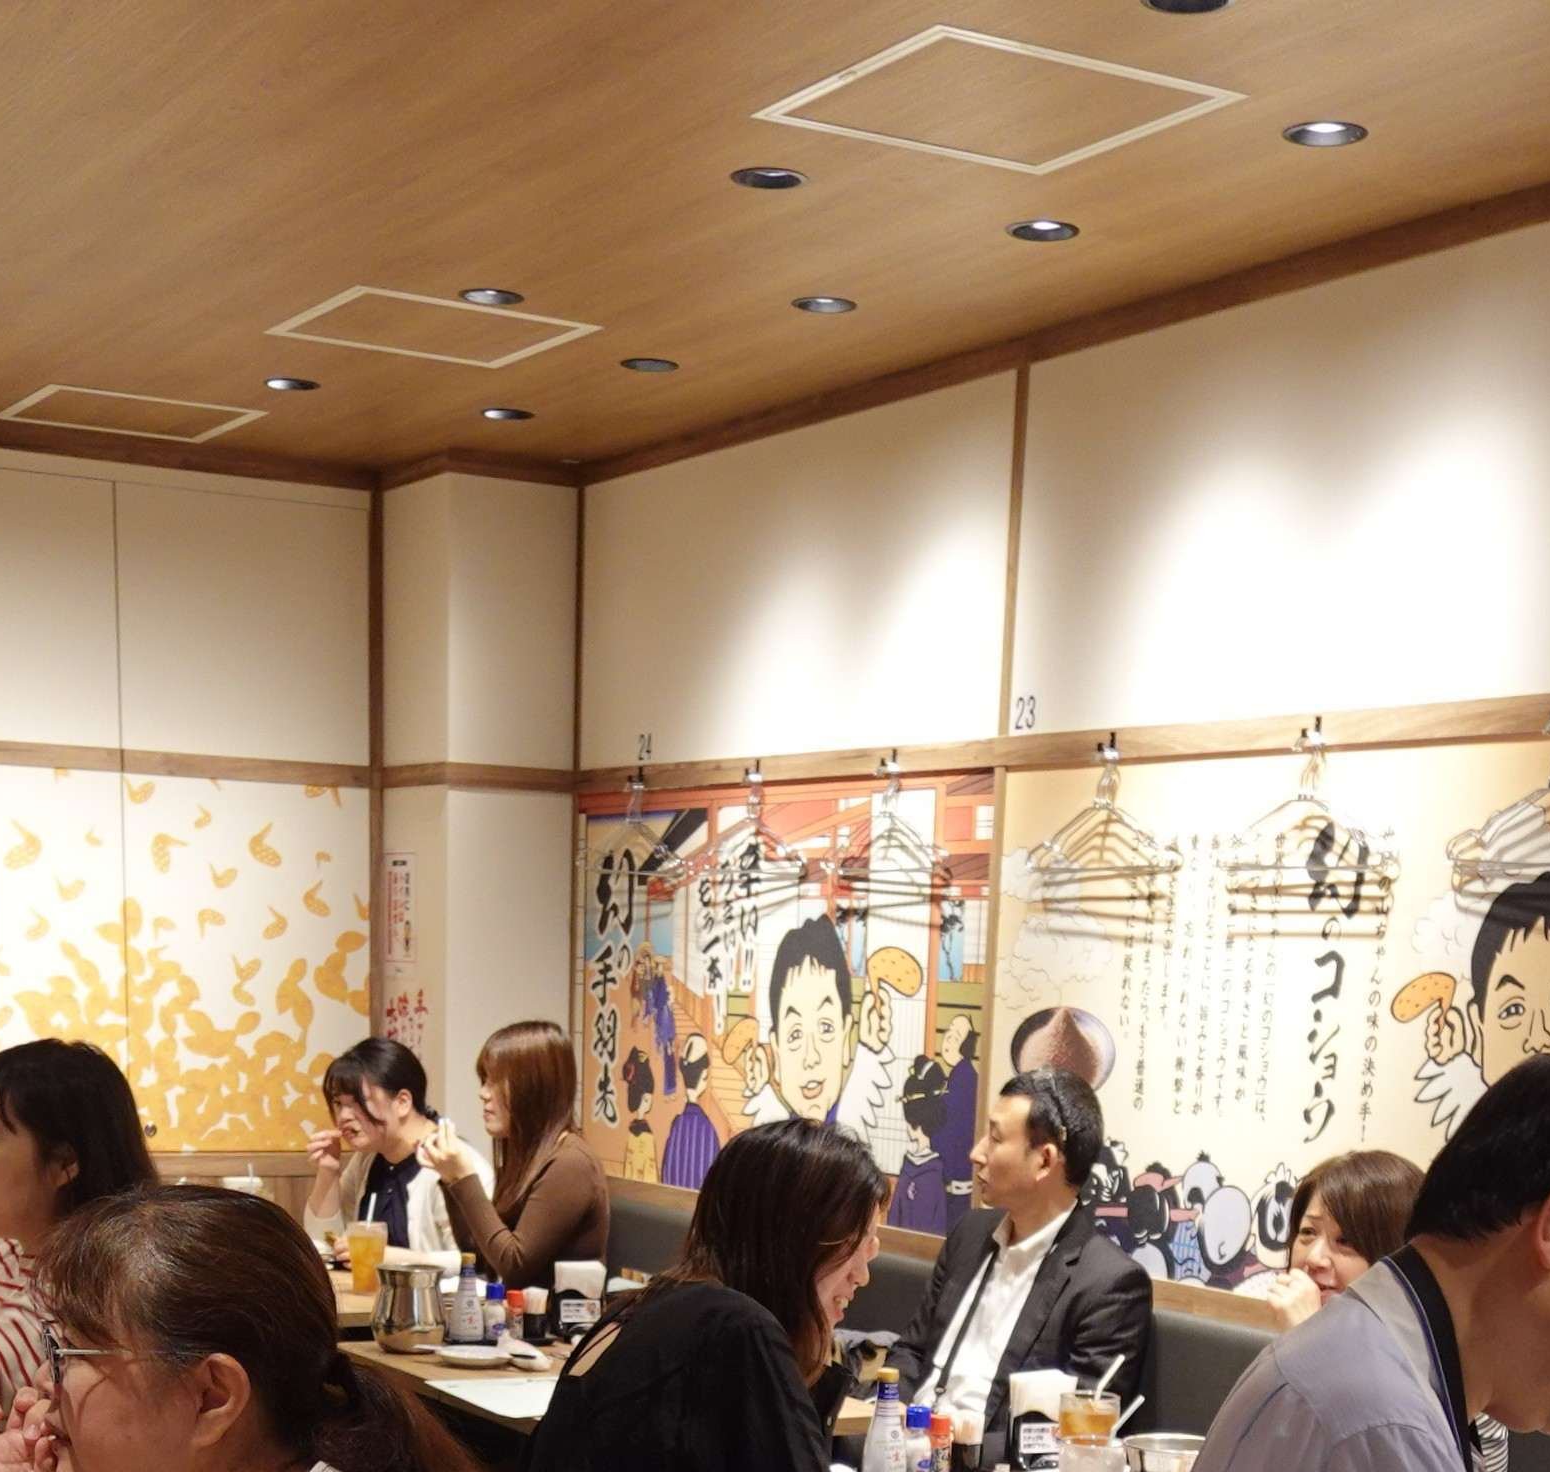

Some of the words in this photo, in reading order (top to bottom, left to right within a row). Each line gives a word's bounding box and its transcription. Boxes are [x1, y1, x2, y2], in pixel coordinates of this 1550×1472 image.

[638, 734, 652, 761] 24
[1015, 697, 1037, 730] 23
[591, 848, 634, 1123] 幻の手羽先
[1303, 821, 1370, 1143] 幻のコショウ
